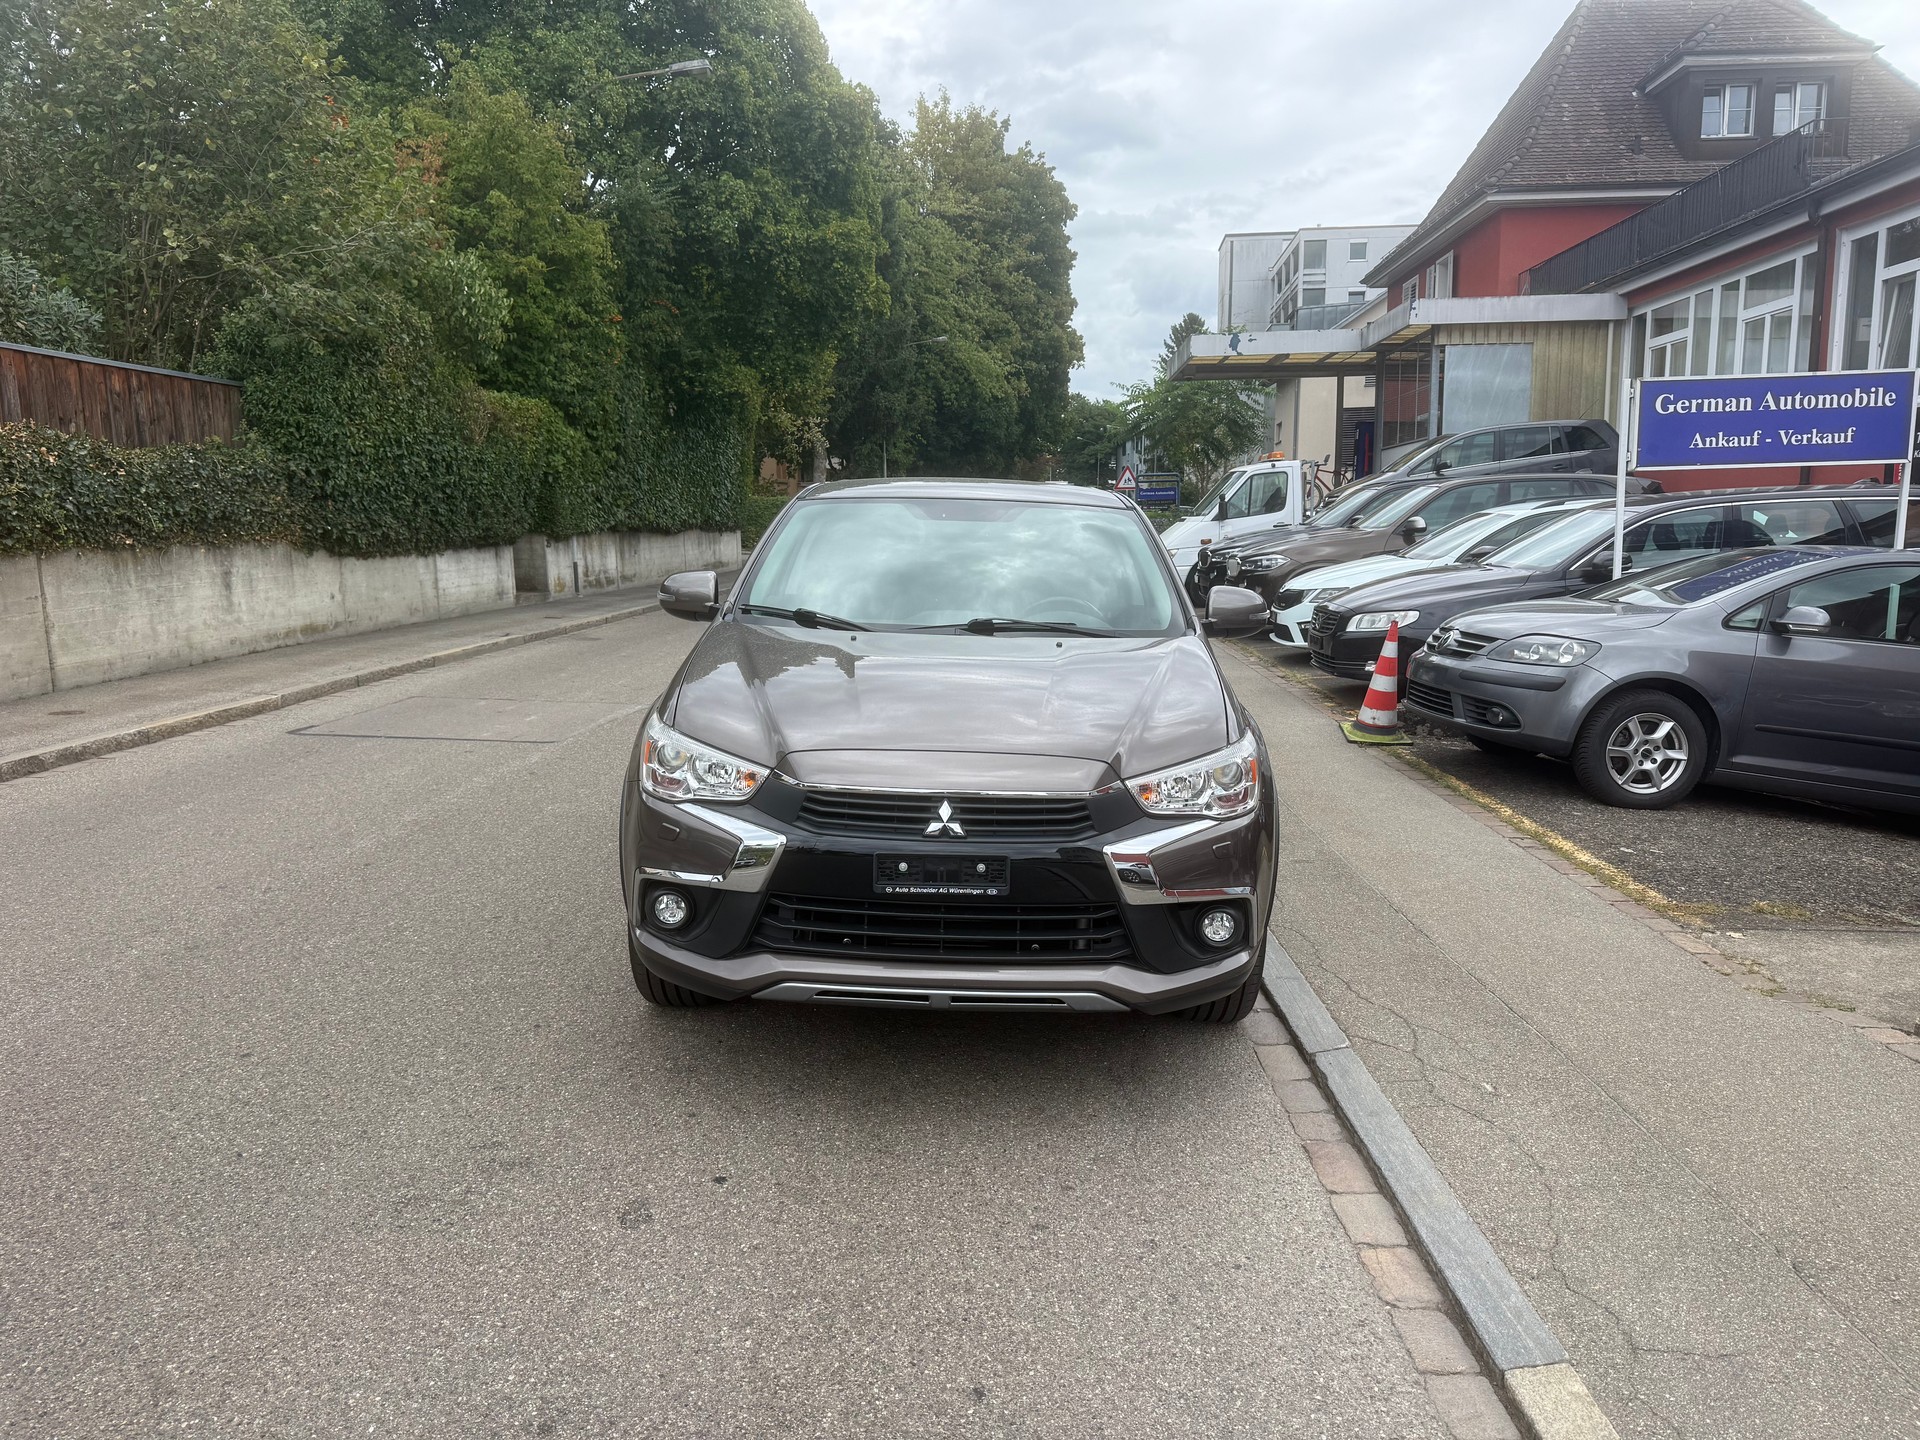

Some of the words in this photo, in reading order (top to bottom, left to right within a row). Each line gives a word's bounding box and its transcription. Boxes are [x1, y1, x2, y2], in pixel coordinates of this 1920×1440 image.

[1655, 394, 1752, 414] German
[1759, 387, 1897, 411] Automobile
[1689, 430, 1762, 448] Ankauf
[1778, 427, 1856, 446] Verkauf
